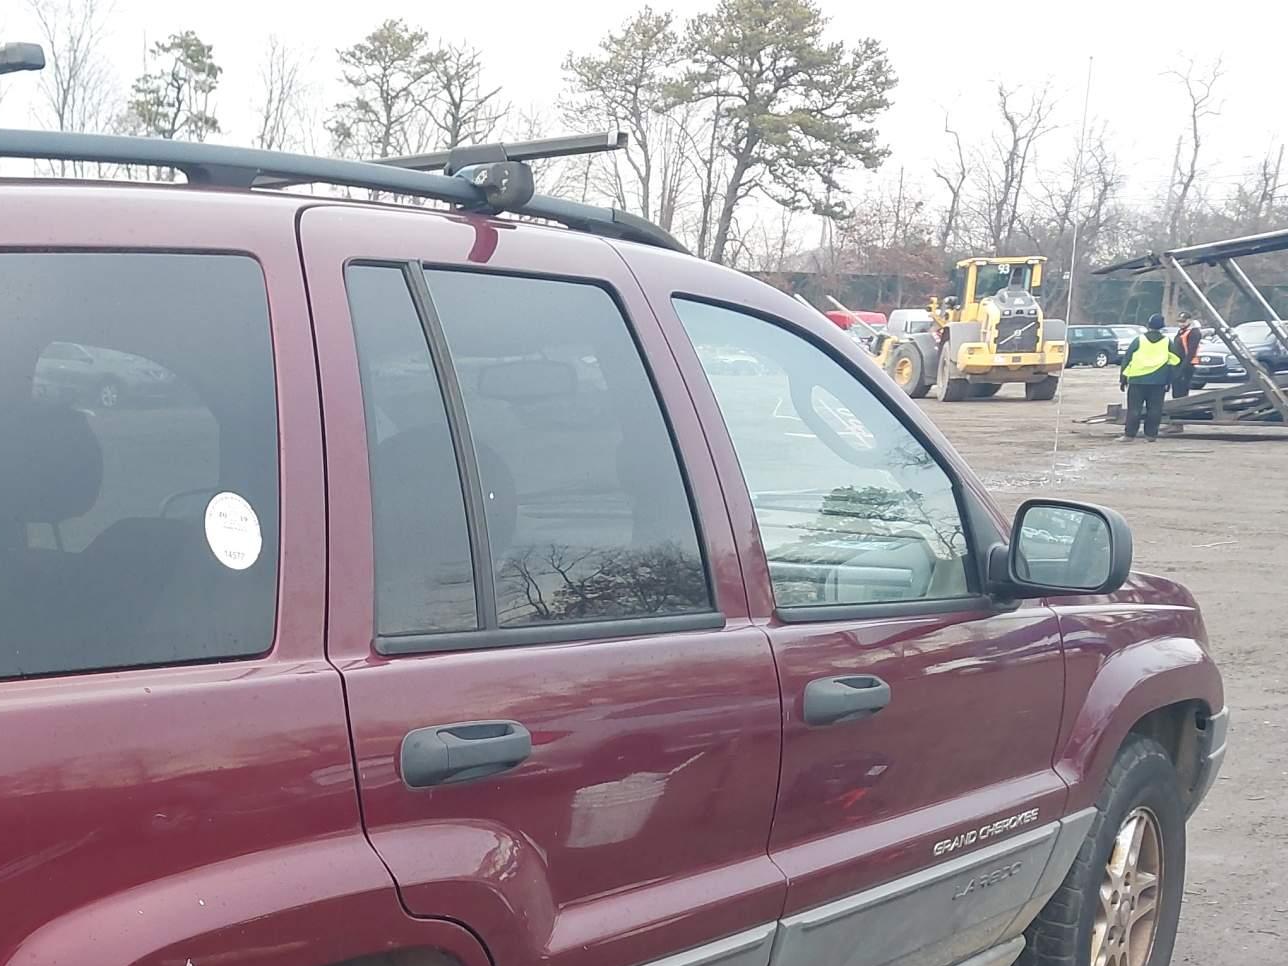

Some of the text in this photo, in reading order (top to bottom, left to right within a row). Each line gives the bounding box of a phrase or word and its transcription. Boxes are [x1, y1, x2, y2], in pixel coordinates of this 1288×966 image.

[998, 263, 1010, 274] 93
[933, 807, 1040, 857] GRAND CHEROKEE
[952, 861, 1023, 901] LAREDO
